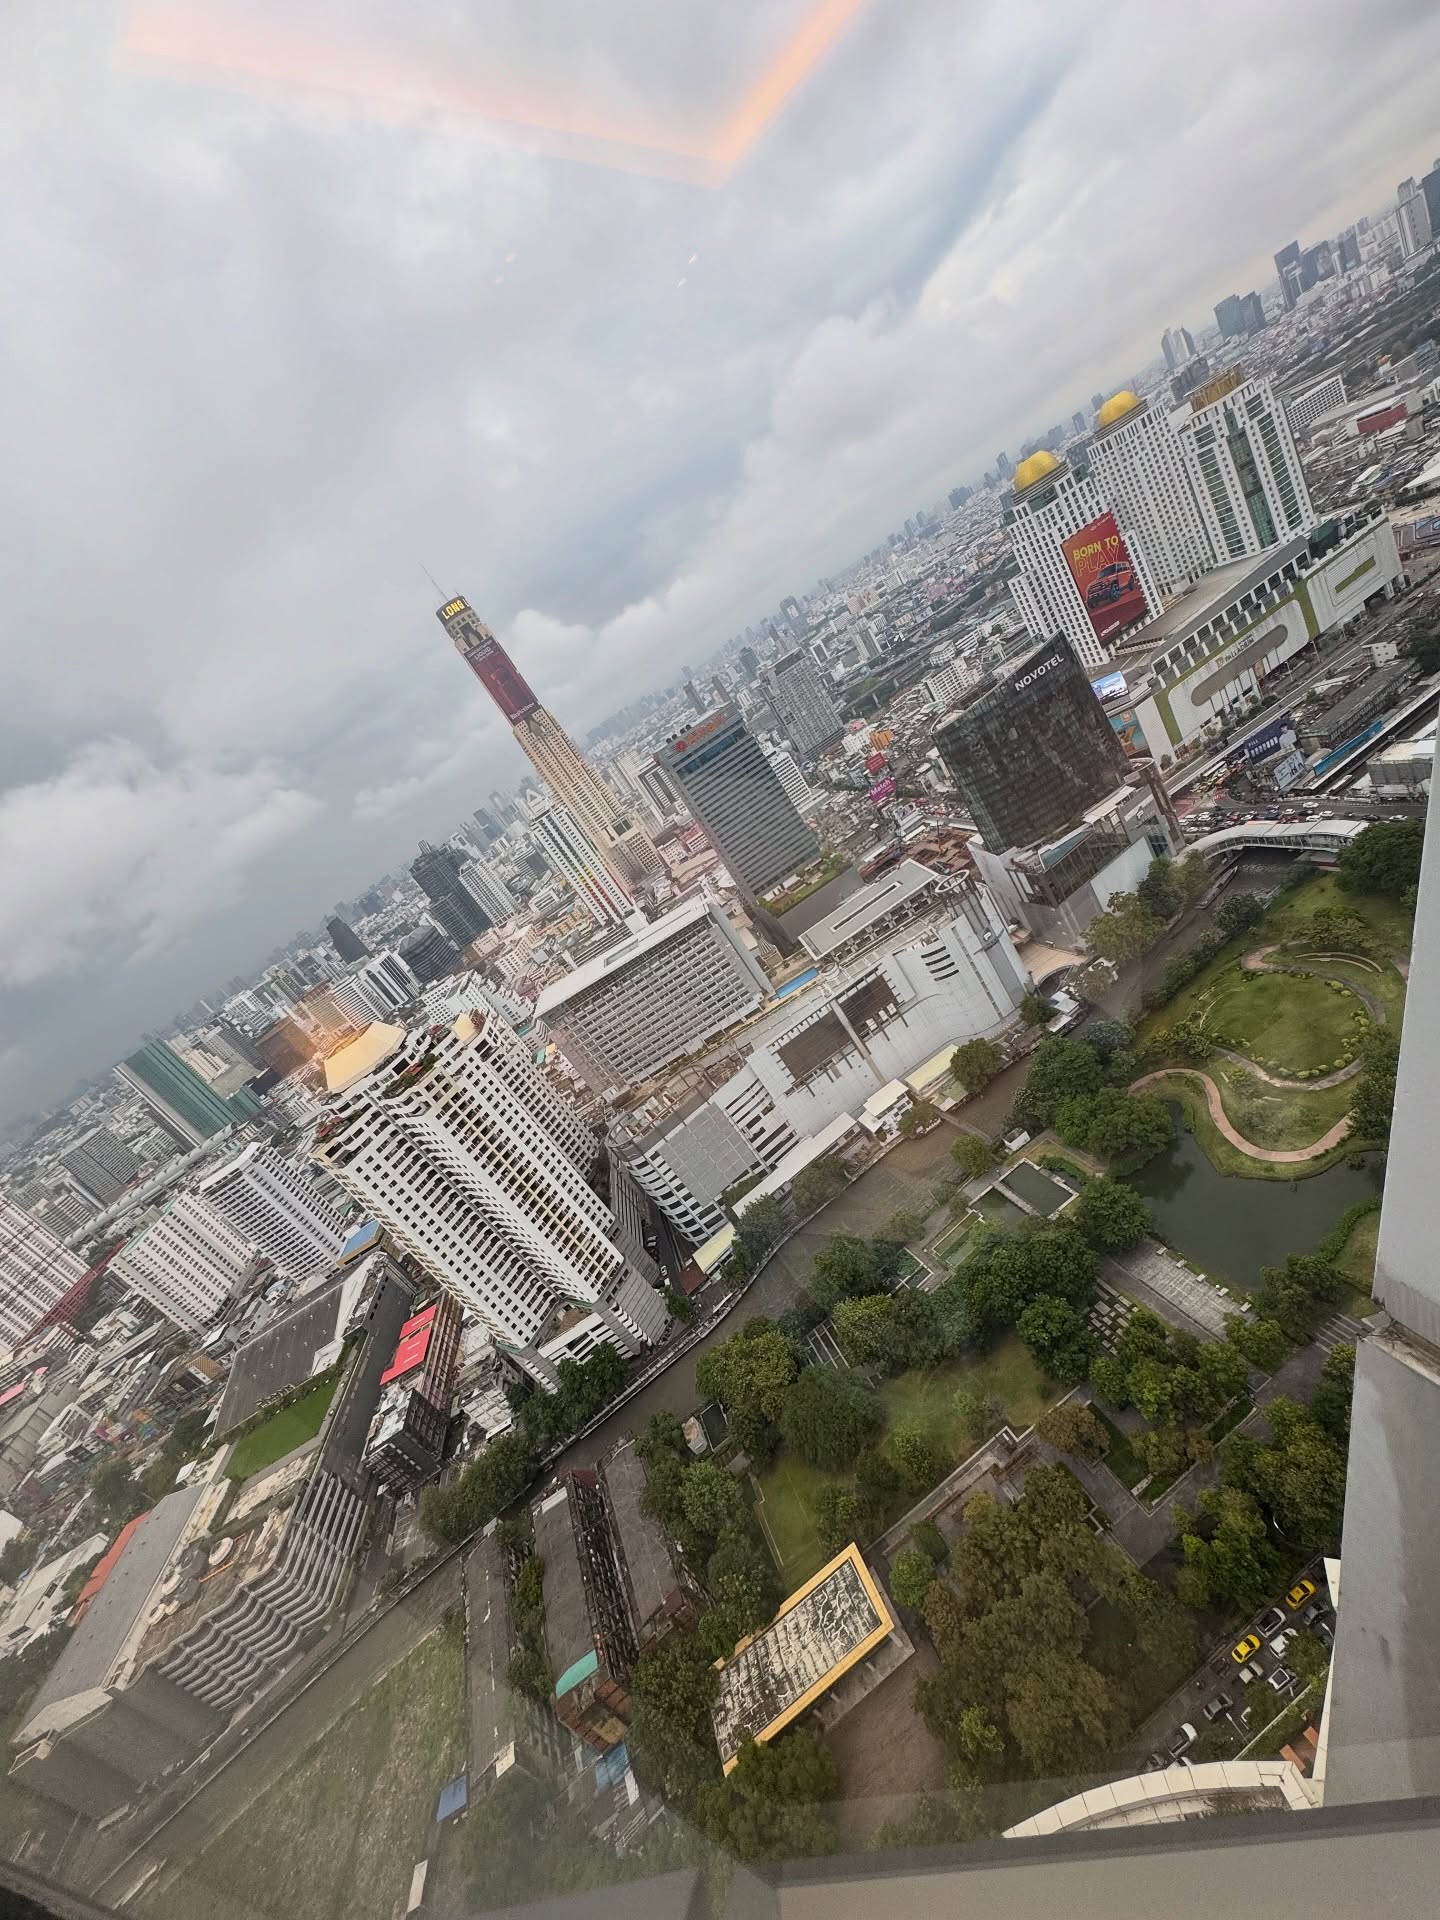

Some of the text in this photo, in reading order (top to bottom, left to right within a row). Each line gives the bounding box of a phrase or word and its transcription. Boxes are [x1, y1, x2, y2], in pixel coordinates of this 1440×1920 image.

[1072, 535, 1119, 560] BORN TO
[1075, 544, 1120, 577] PLAY
[442, 600, 465, 620] LONG
[474, 646, 491, 660] LIQUID
[1225, 638, 1254, 662] PALLADIUM
[1014, 654, 1064, 691] NOVOTEL
[871, 779, 891, 796] Match
